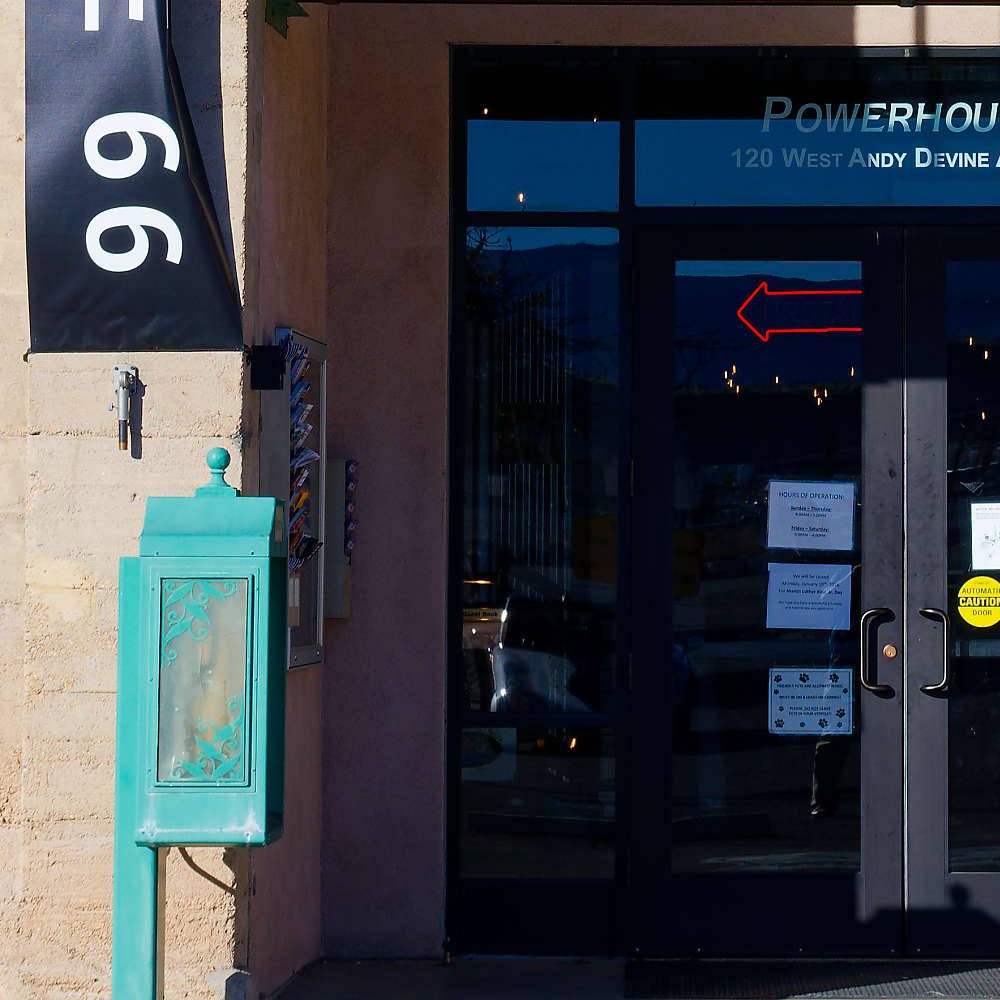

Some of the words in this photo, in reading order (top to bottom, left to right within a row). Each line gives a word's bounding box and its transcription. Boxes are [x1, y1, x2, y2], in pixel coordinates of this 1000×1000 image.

[84, 111, 183, 273] 66
[731, 148, 773, 168] 120
[781, 148, 843, 168] WEST
[848, 148, 907, 168] ANDY
[915, 147, 990, 168] DEVINE
